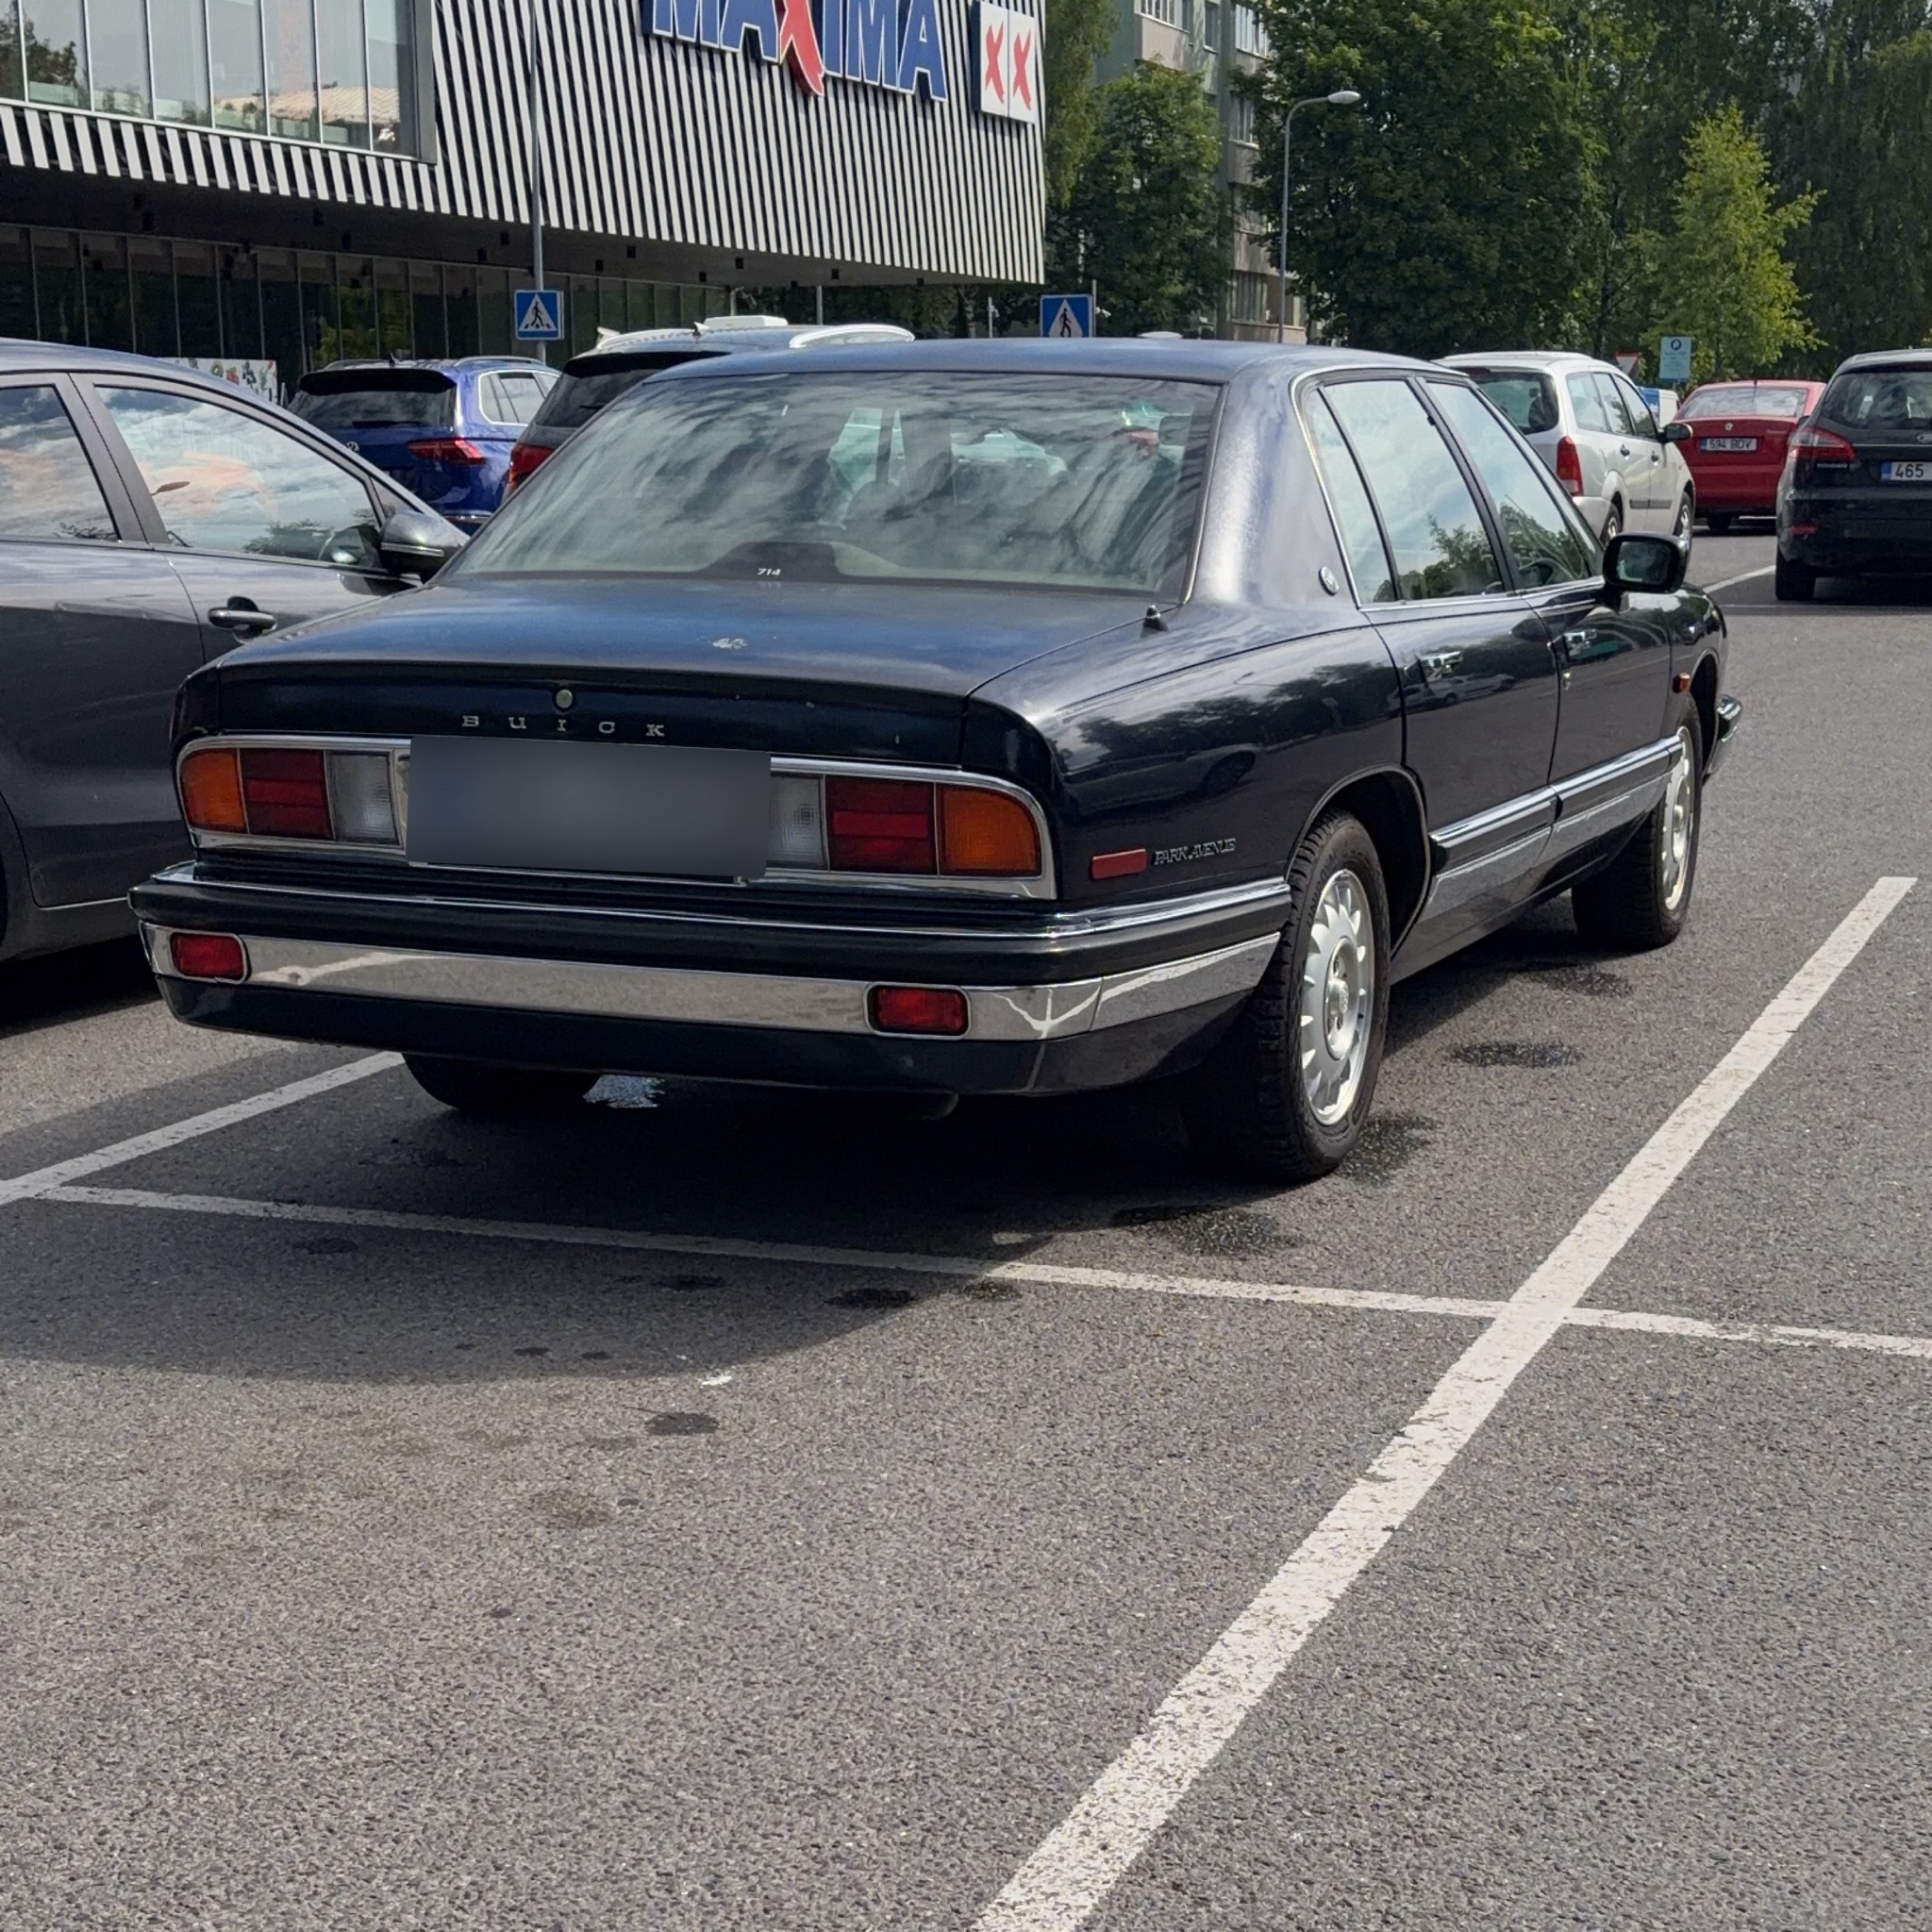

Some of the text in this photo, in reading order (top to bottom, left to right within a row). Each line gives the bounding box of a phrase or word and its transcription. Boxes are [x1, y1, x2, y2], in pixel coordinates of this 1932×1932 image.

[651, 0, 947, 102] XIMA
[1895, 463, 1924, 478] 465
[461, 715, 665, 737] BUICK
[1154, 846, 1189, 865] PARK
